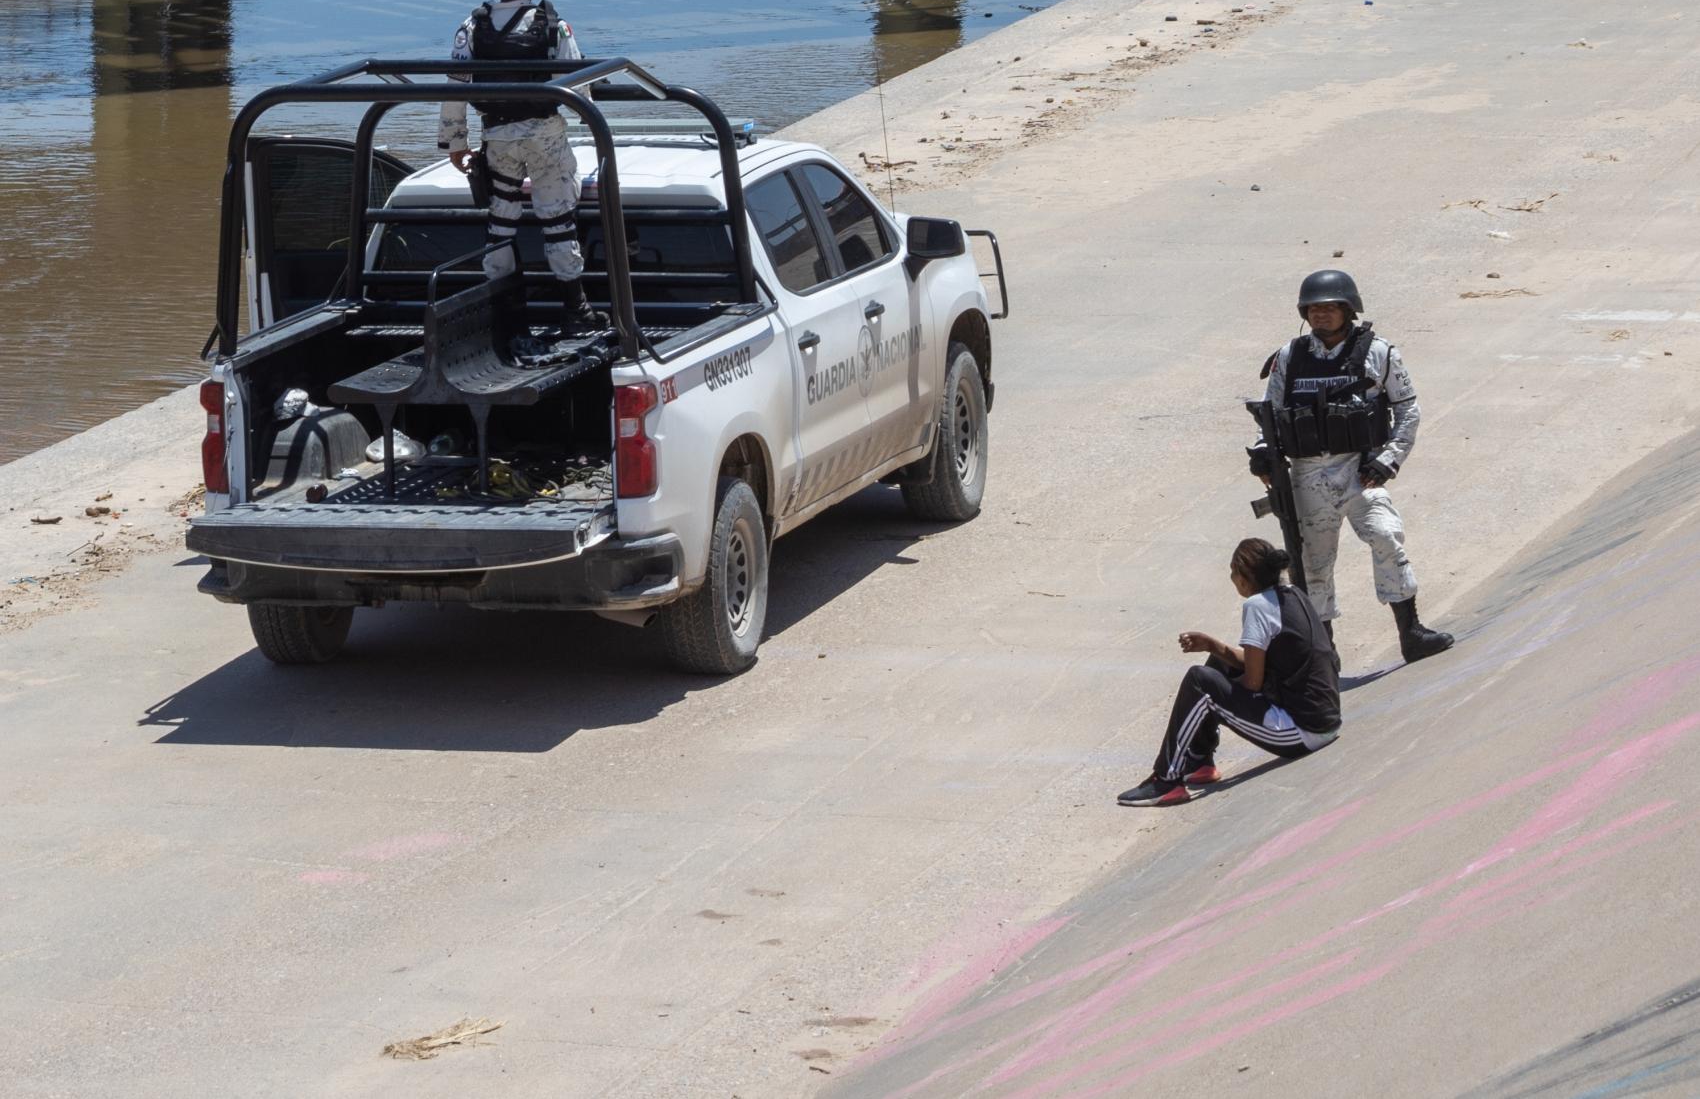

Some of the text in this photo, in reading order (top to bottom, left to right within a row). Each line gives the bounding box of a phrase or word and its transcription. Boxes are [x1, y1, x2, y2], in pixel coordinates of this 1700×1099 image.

[703, 346, 753, 392] GN331307
[806, 323, 927, 406] GUARDIA NACIONAL
[661, 380, 678, 402] 911
